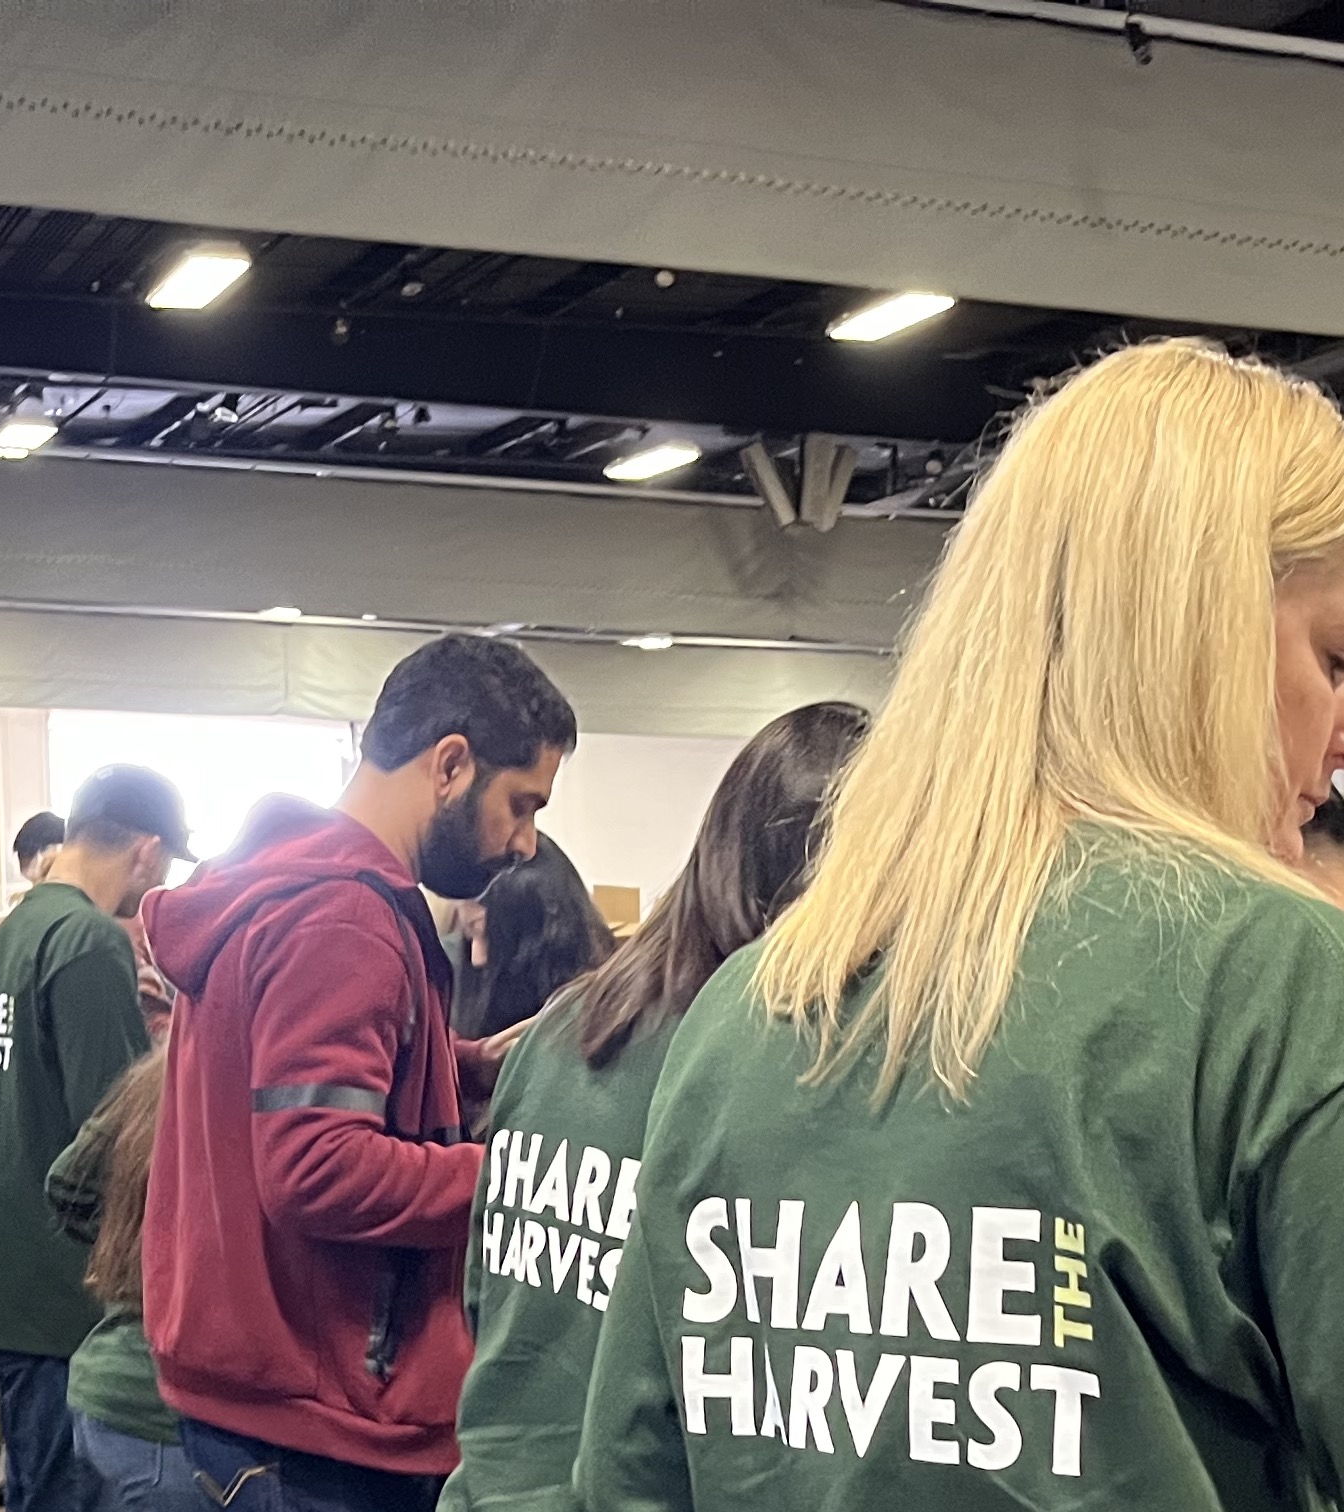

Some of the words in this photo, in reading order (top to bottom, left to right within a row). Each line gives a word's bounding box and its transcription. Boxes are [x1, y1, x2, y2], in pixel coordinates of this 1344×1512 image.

[482, 1209, 624, 1312] HARVES
[682, 1197, 1042, 1346] SHARE
[1054, 1216, 1094, 1348] THE
[681, 1336, 1101, 1477] HARVEST
